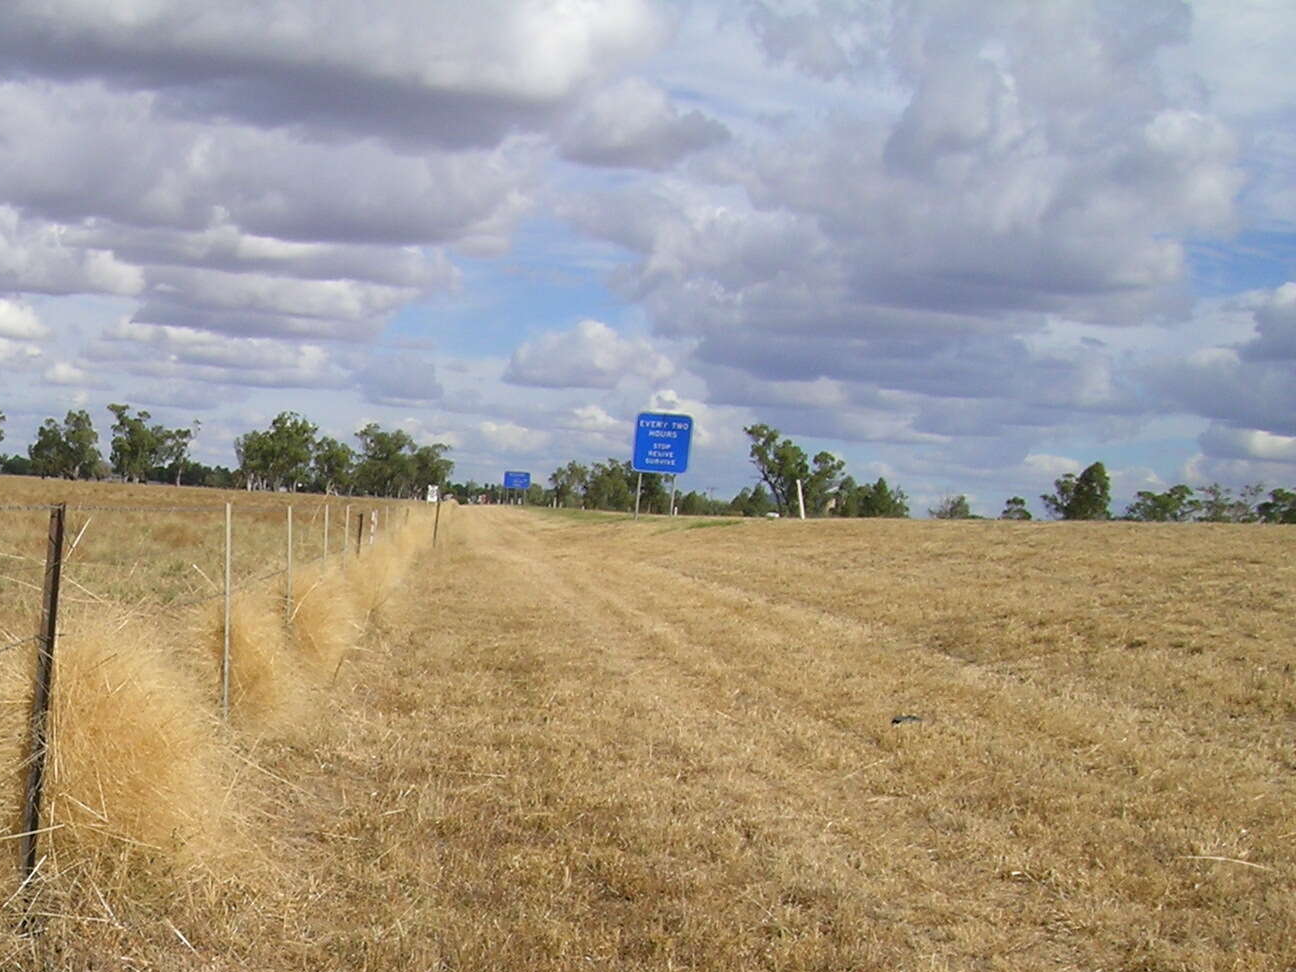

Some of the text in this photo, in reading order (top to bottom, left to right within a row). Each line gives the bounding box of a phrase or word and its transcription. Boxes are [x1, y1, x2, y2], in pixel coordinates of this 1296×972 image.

[640, 420, 689, 430] EVERY TWO
[648, 430, 677, 438] HOURS
[648, 450, 674, 458] REVIVE
[645, 458, 676, 466] SURVIVE
